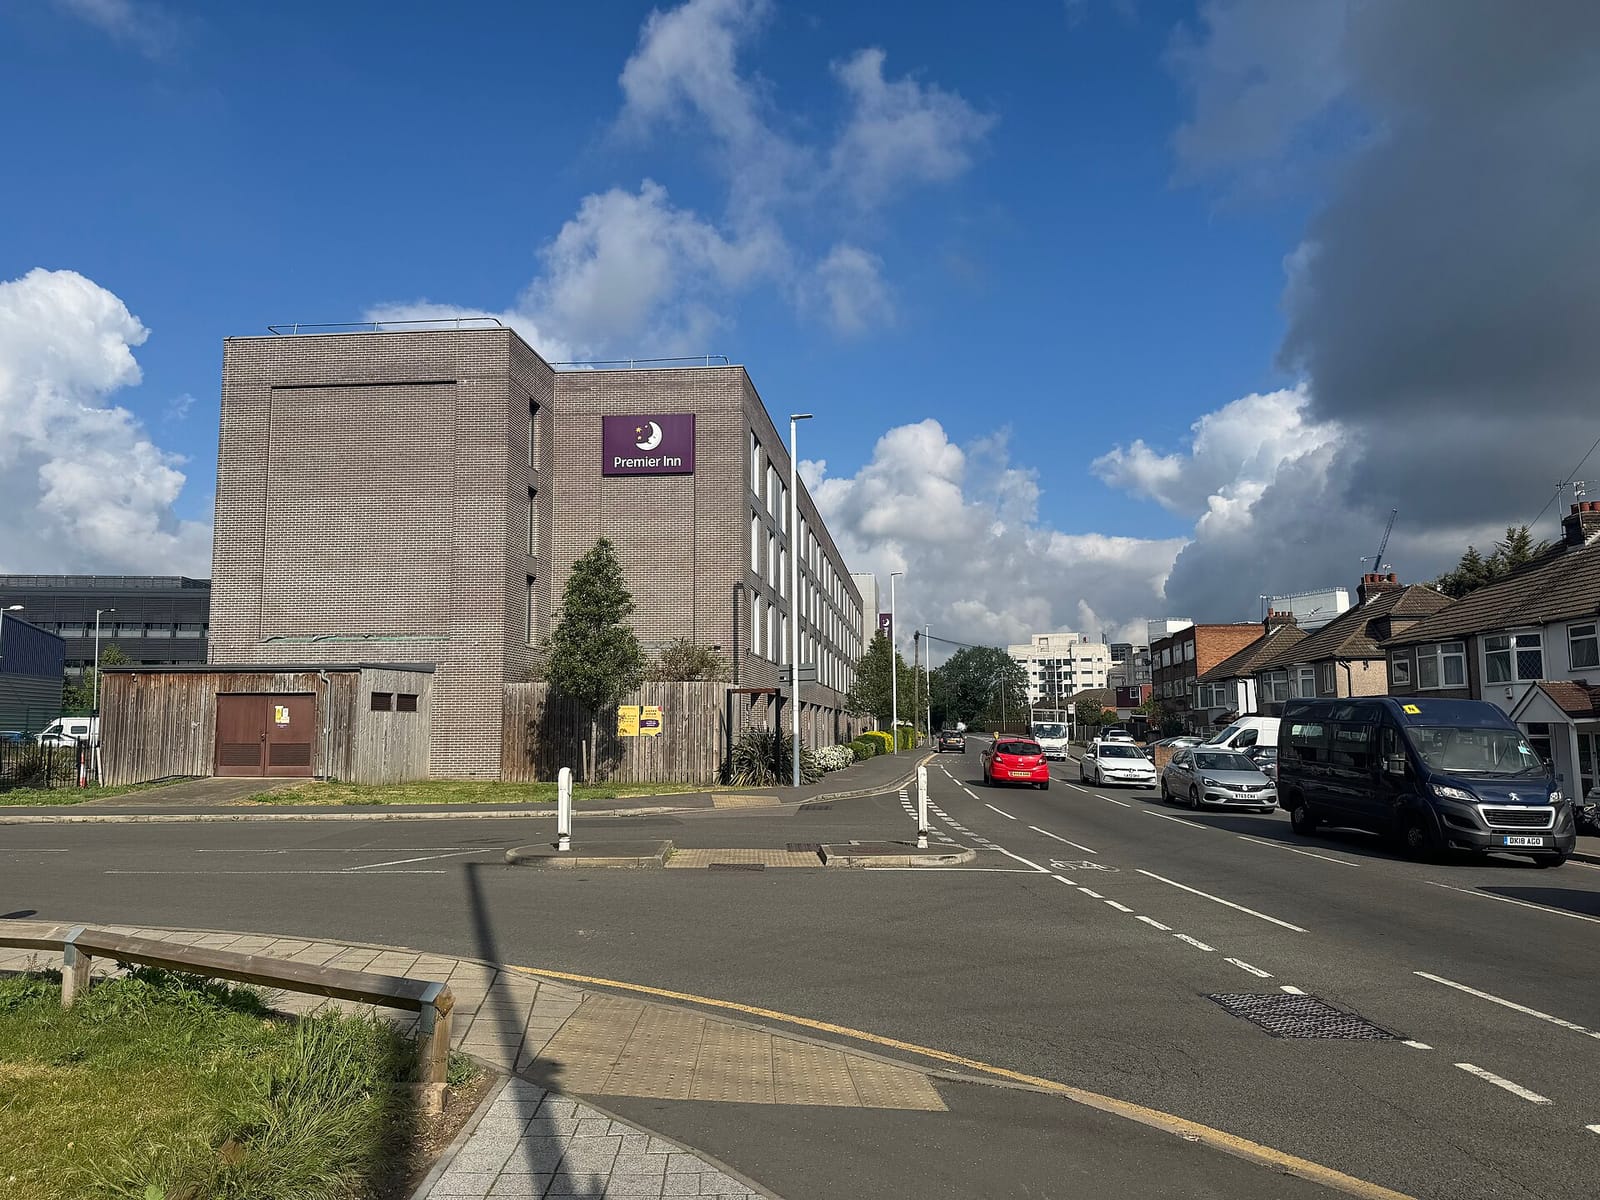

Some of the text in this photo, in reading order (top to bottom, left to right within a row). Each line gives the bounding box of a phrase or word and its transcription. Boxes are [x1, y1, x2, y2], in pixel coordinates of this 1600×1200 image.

[614, 455, 682, 468] Premier Inn
[1509, 837, 1526, 845] DK18
